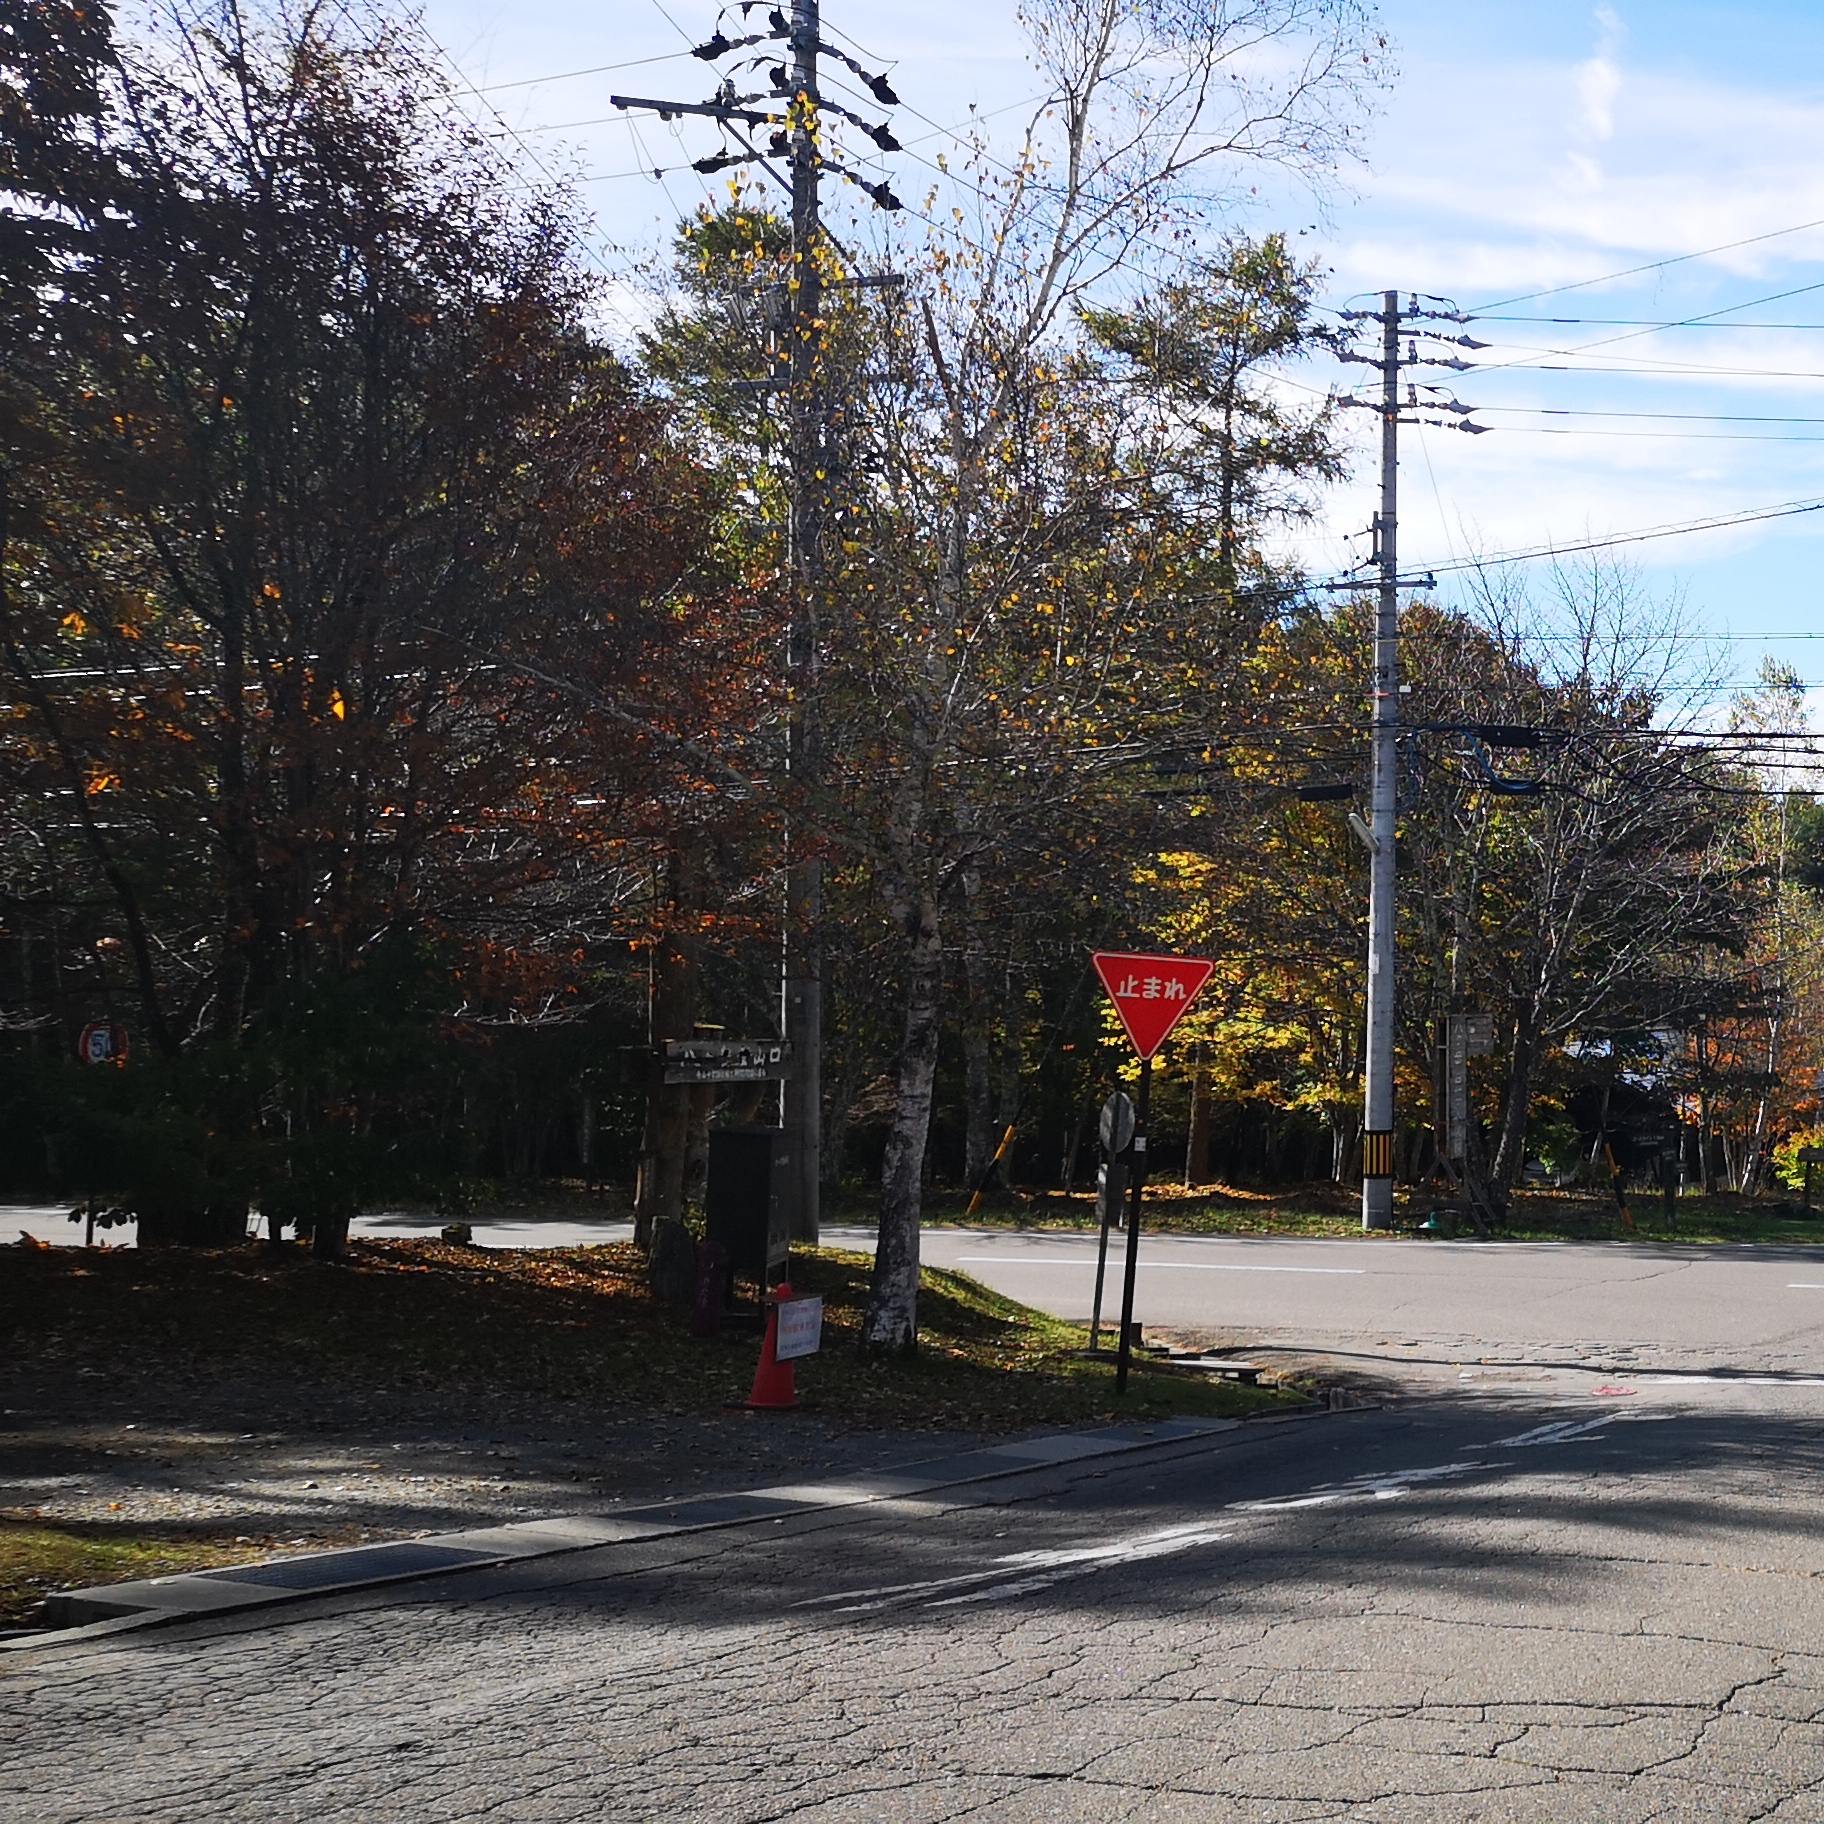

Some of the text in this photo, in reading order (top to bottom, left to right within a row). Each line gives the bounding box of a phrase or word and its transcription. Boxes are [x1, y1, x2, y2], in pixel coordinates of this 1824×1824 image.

[1116, 974, 1187, 1000] 止まれ
[91, 1033, 108, 1057] 5
